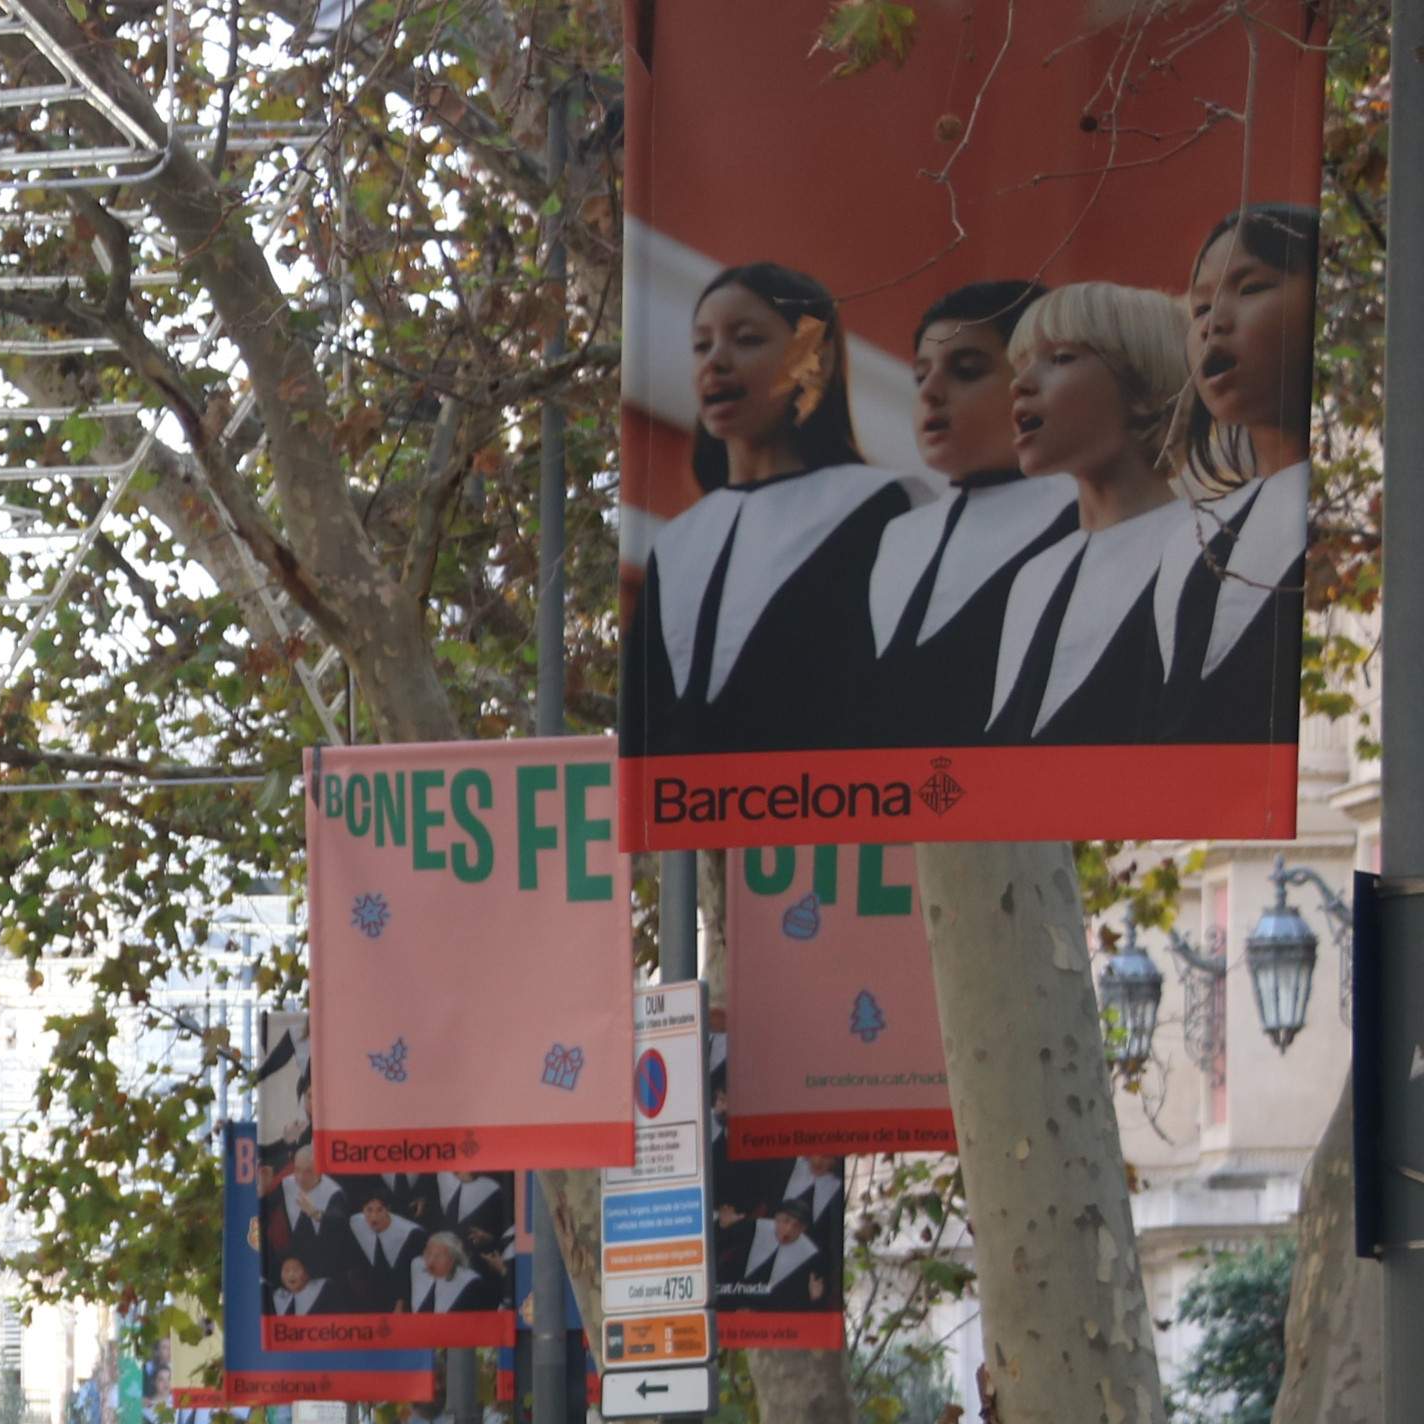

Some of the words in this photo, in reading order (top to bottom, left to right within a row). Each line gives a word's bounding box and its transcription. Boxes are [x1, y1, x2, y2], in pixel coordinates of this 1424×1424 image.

[654, 773, 911, 824] Barcelona
[646, 995, 665, 1015] DUM
[805, 1072, 948, 1089] barcelona.cat/nada
[793, 1130, 869, 1144] Barcelona
[873, 1128, 893, 1142] de
[900, 1128, 911, 1141] la
[331, 1139, 456, 1163] Barcelona
[663, 1275, 693, 1300] 4750
[273, 1322, 373, 1342] Barcelona
[234, 1374, 316, 1394] Barcelona
